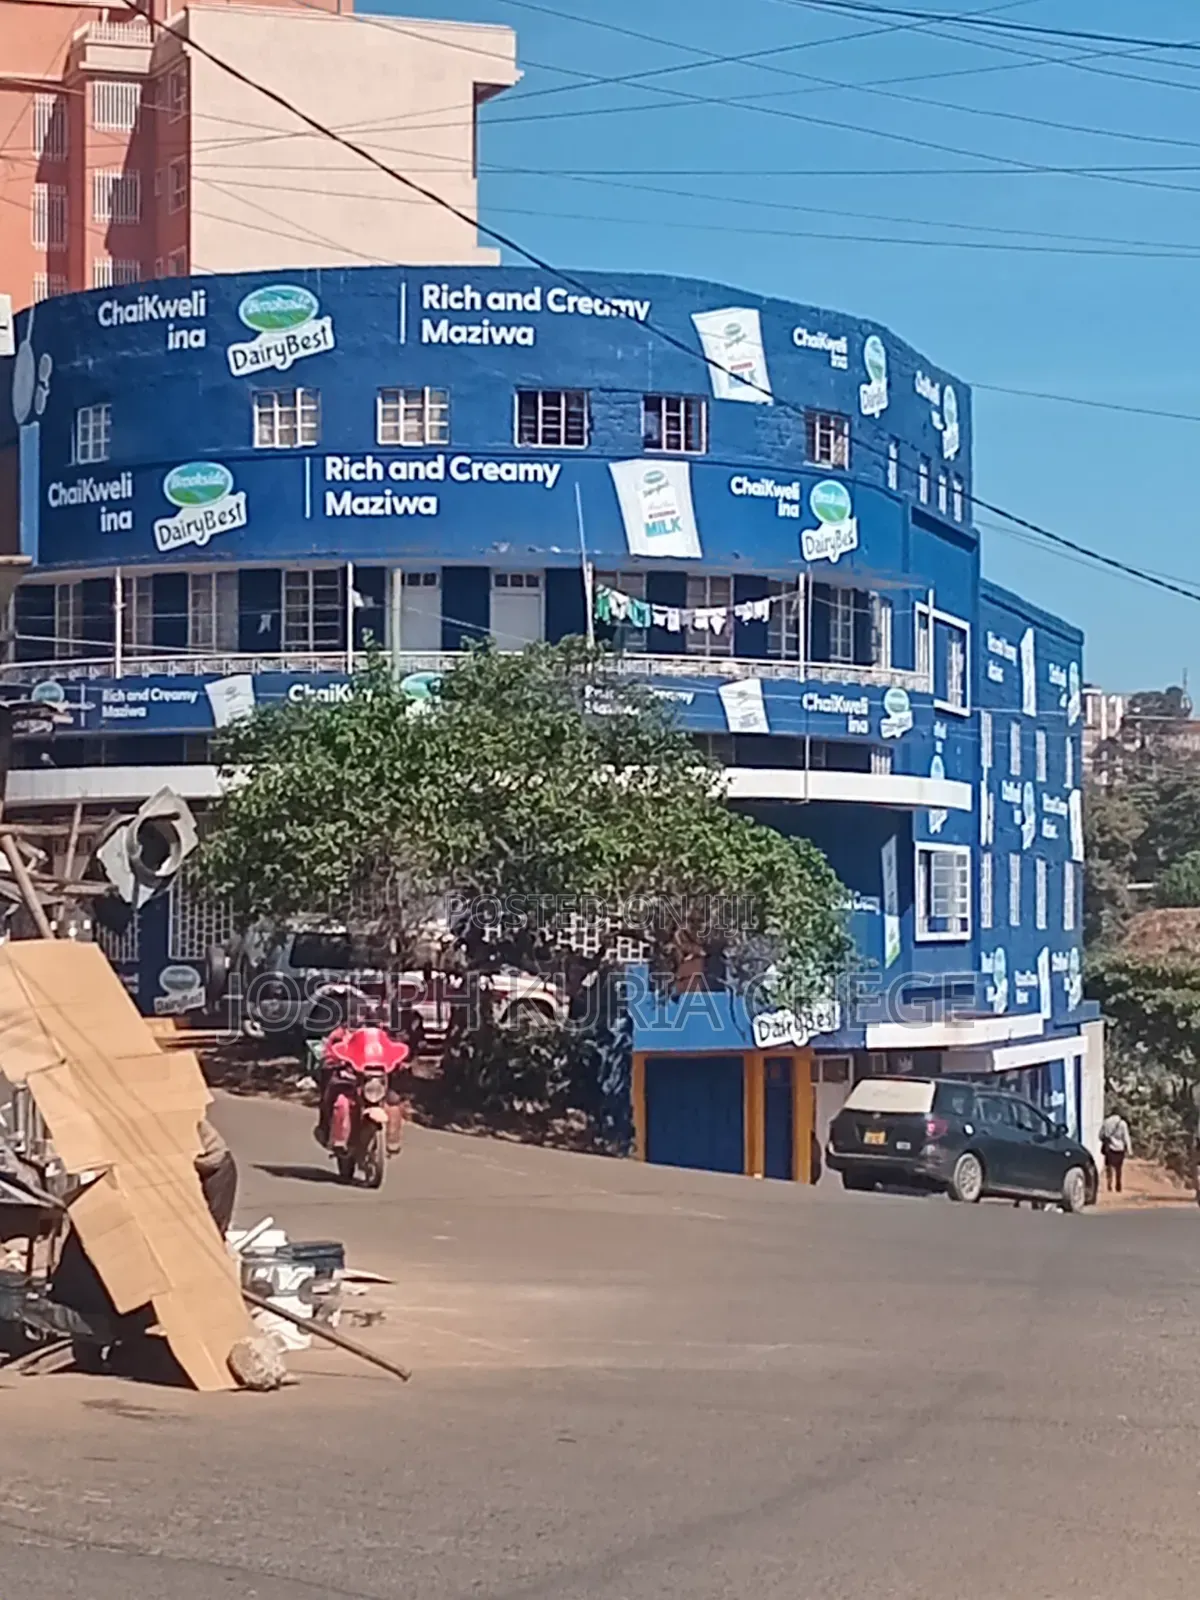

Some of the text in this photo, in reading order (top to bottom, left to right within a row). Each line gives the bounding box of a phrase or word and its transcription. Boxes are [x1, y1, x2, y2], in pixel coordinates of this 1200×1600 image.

[98, 289, 206, 328] ChaiKweli
[422, 284, 651, 321] Rich and Creamy
[167, 325, 206, 350] ina
[421, 318, 535, 346] Maziwa
[232, 325, 328, 370] DairyBest
[325, 455, 561, 488] Rich and Creamy
[48, 472, 133, 508] ChaiKweli
[325, 488, 438, 516] Maziwa
[730, 475, 800, 501] ChaiKweli
[100, 507, 132, 532] ina
[158, 501, 243, 545] DairyBest
[150, 688, 198, 704] Creamy
